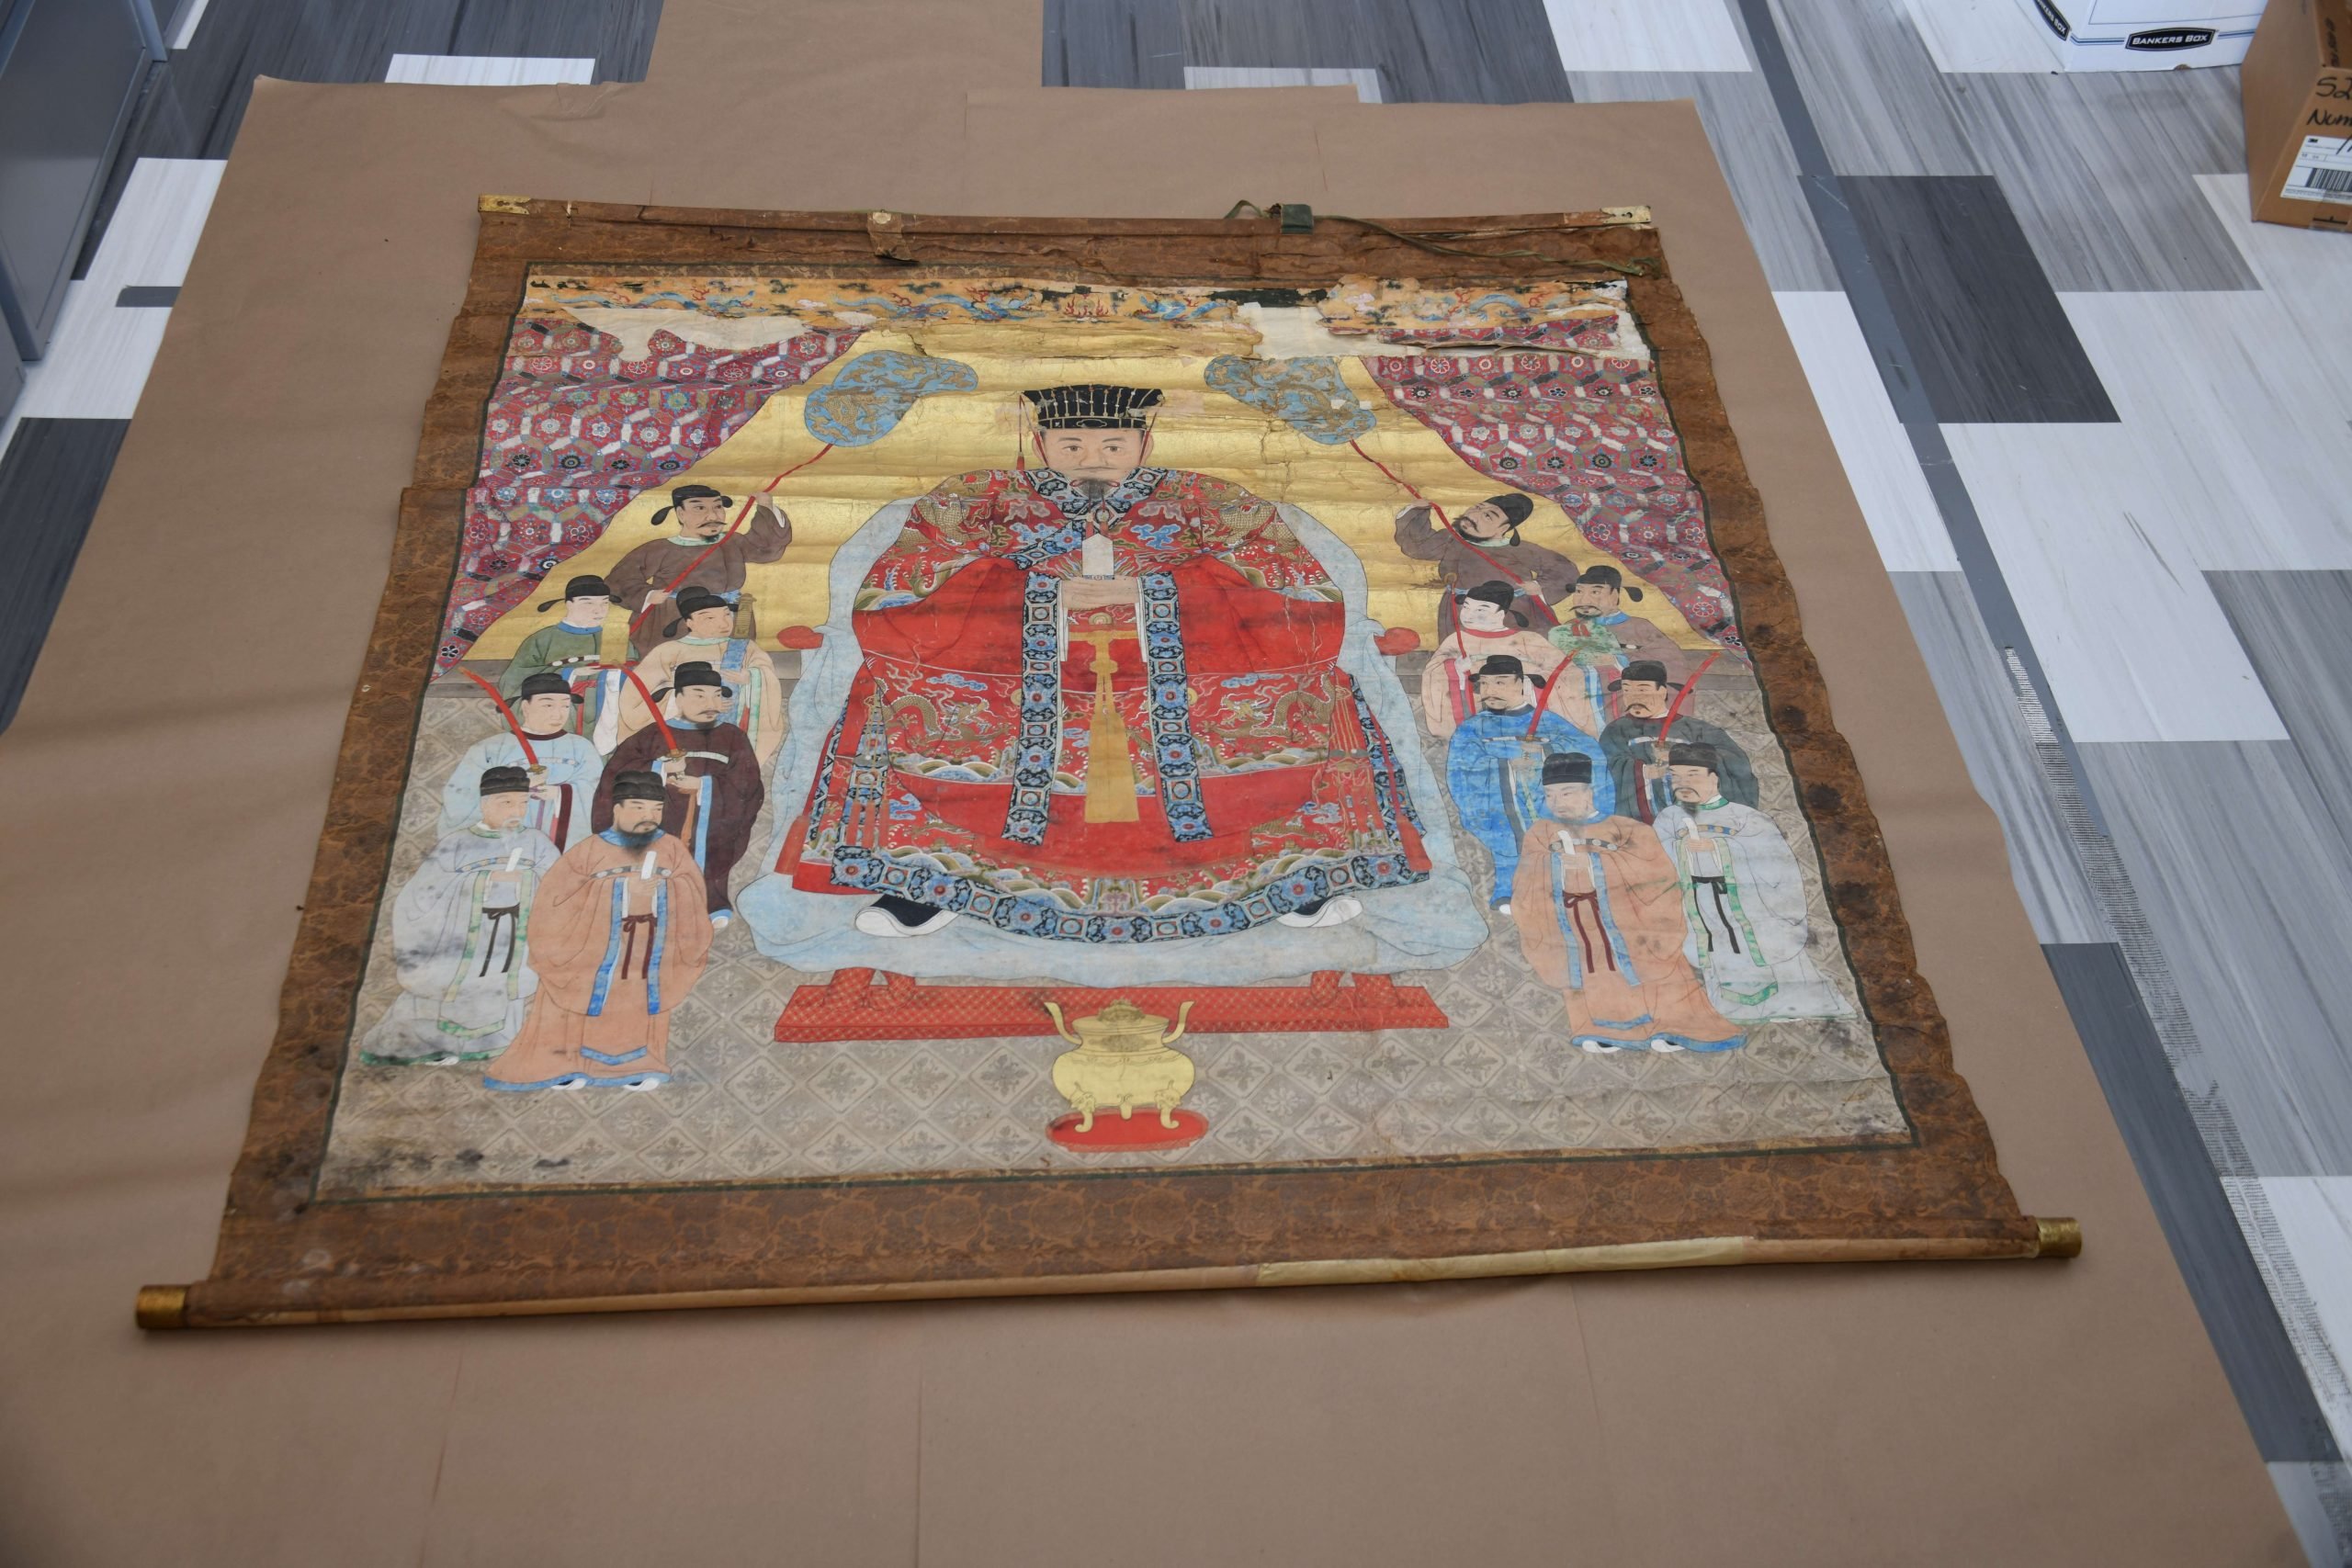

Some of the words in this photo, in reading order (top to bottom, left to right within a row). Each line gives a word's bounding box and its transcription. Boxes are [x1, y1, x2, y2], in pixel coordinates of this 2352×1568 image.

[2053, 17, 2066, 34] BOX
[2132, 36, 2183, 45] BANKERS
[2185, 34, 2209, 43] BOX
